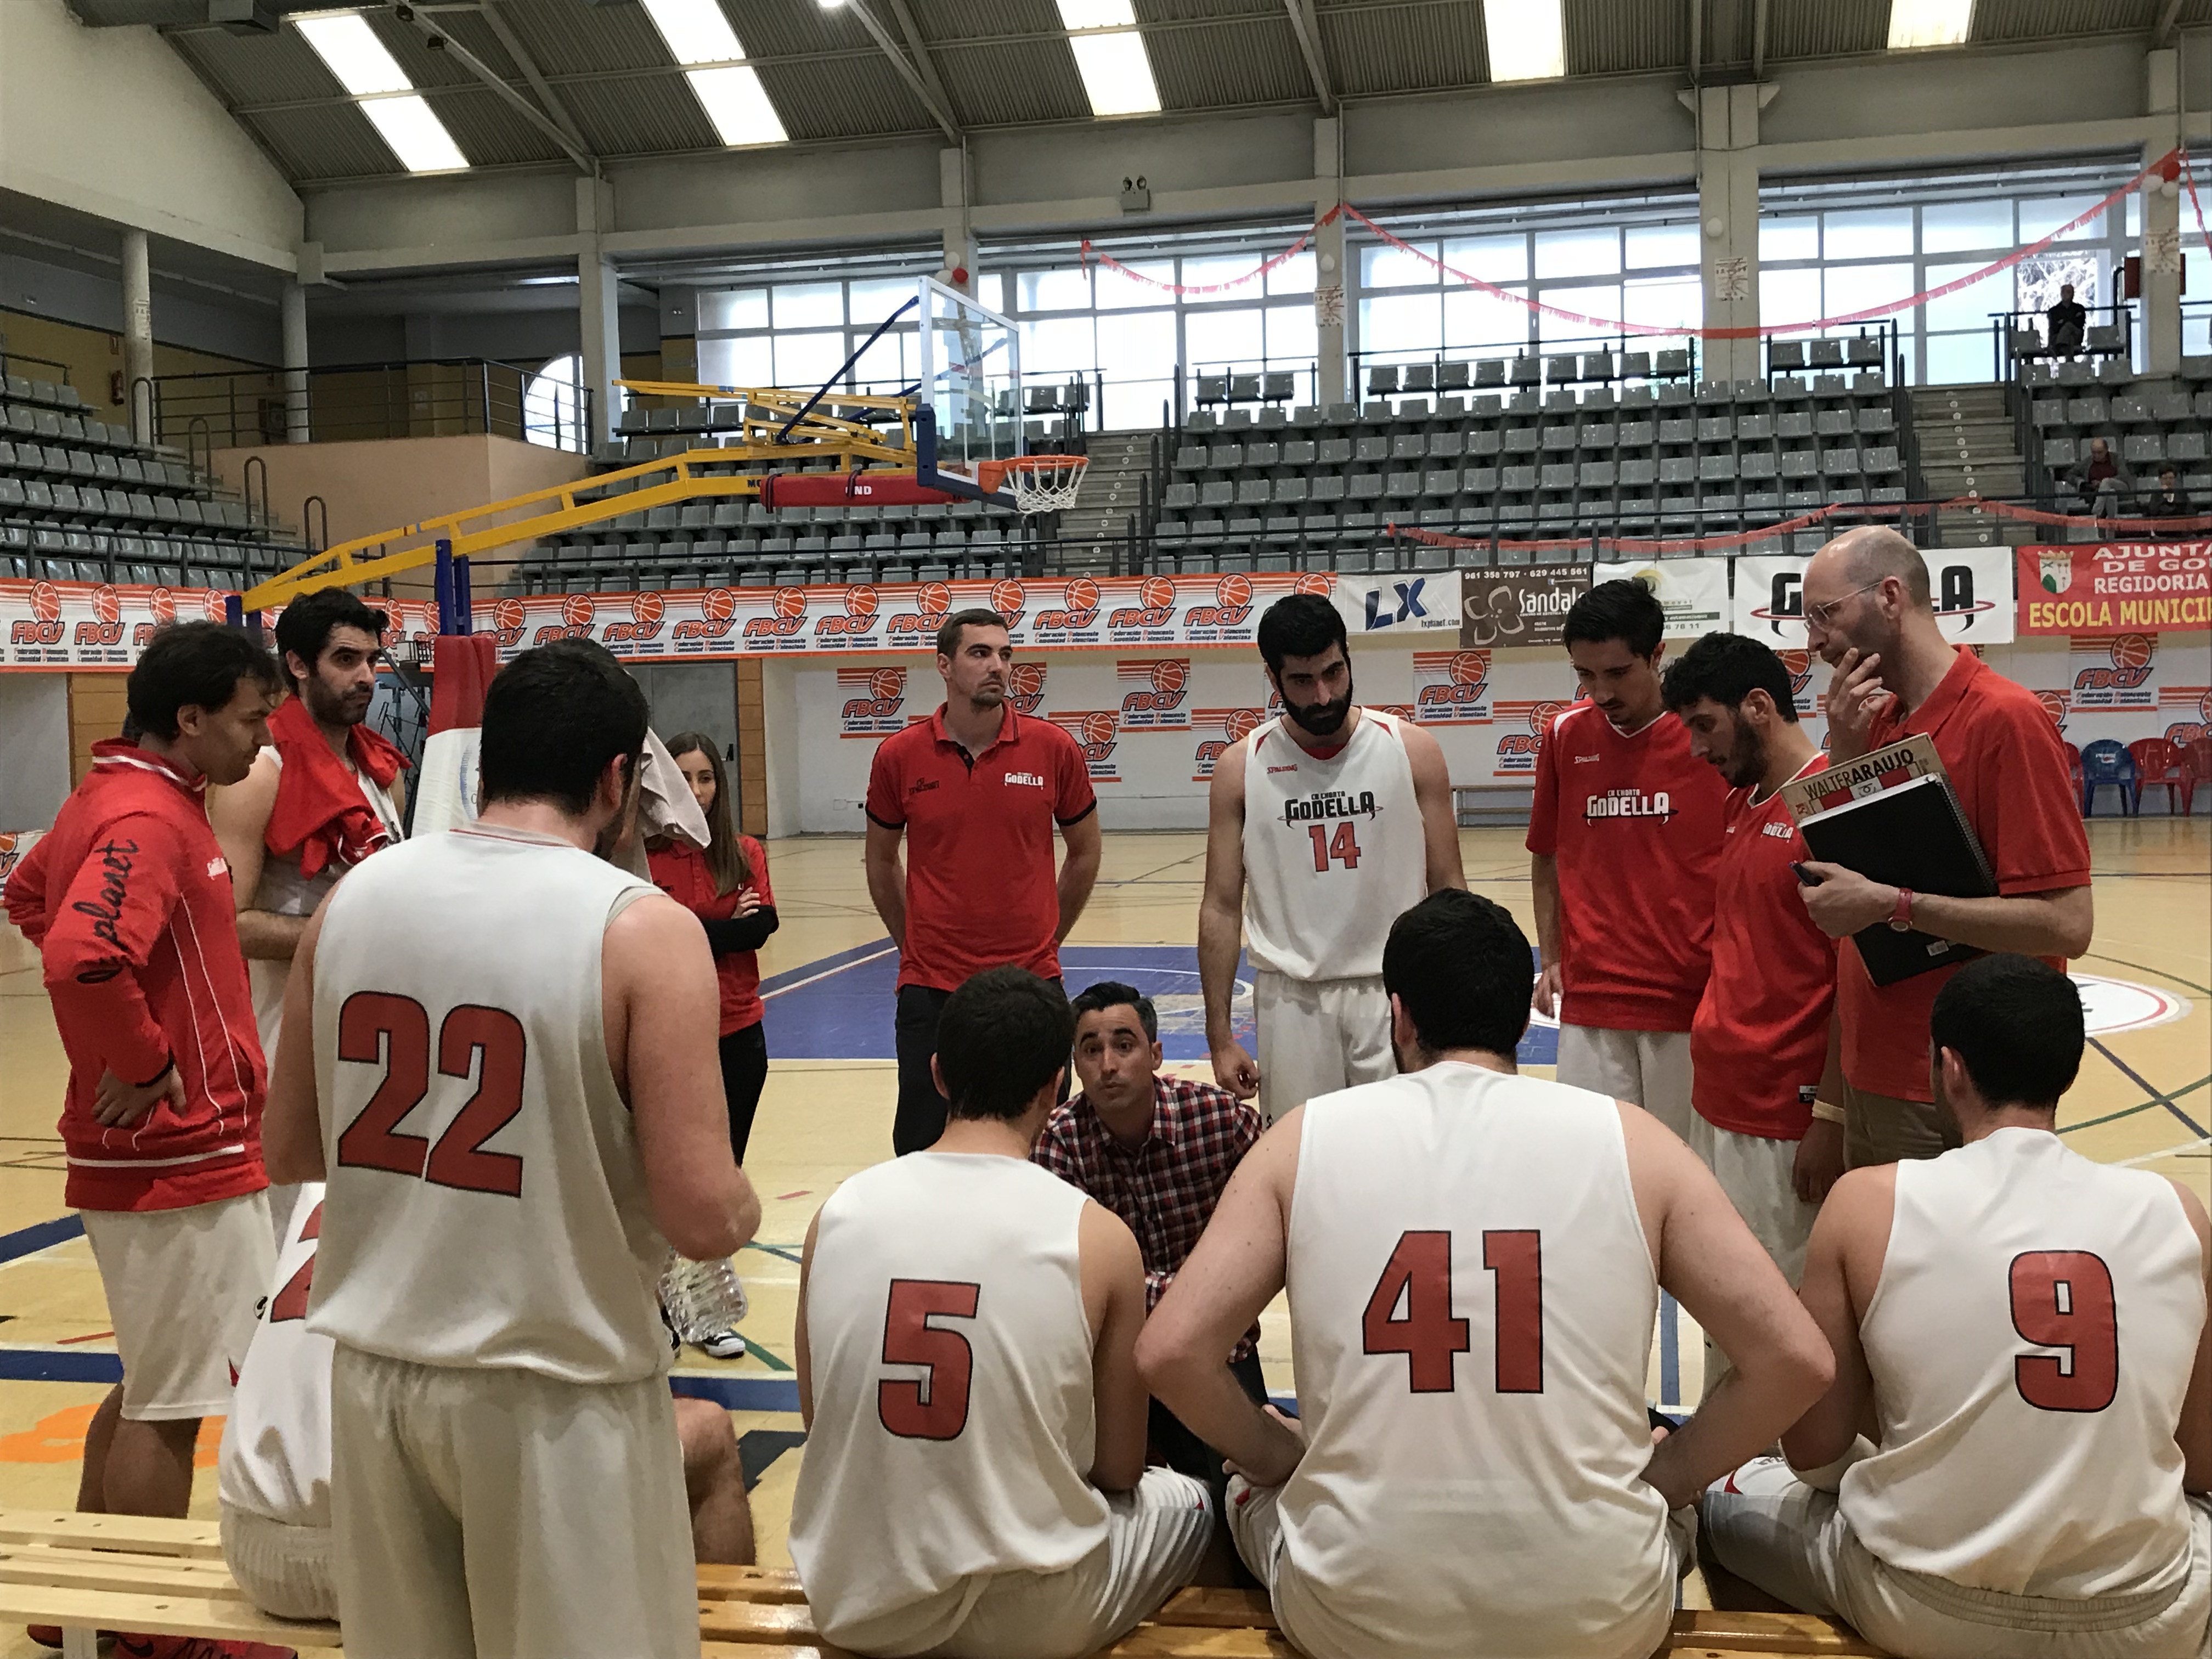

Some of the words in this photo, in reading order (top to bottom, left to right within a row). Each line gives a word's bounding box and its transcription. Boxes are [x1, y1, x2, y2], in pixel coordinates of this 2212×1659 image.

[2103, 560, 2146, 573] DE
[2159, 558, 2212, 571] GO
[2094, 573, 2209, 594] REGIDORIA
[1365, 577, 1430, 631] LX
[2030, 602, 2112, 628] ESCOLA
[743, 617, 808, 636] FBCV
[814, 614, 880, 635] FBCV
[1032, 609, 1101, 630] FBCV
[1108, 607, 1177, 628] FBCV
[1183, 606, 1254, 627] FBCV
[11, 620, 65, 645] FBCV
[74, 622, 126, 645] FBCV
[602, 621, 666, 641] FBCV
[672, 619, 737, 639] FBCV
[2074, 667, 2154, 690] FBCV
[1122, 691, 1187, 711] FBCV
[1418, 683, 1488, 705] FBCV
[842, 698, 904, 718] FBCV
[1005, 772, 1043, 789] GODELLA
[1803, 749, 1914, 800] WALTERARAUJO
[1285, 791, 1376, 827] GODELLA
[1587, 792, 1669, 824] GODELLA
[1308, 821, 1361, 872] 14
[338, 991, 526, 1198] 22
[1362, 1229, 1543, 1394] 41
[2008, 1250, 2119, 1413] 9
[878, 1278, 980, 1441] 5
